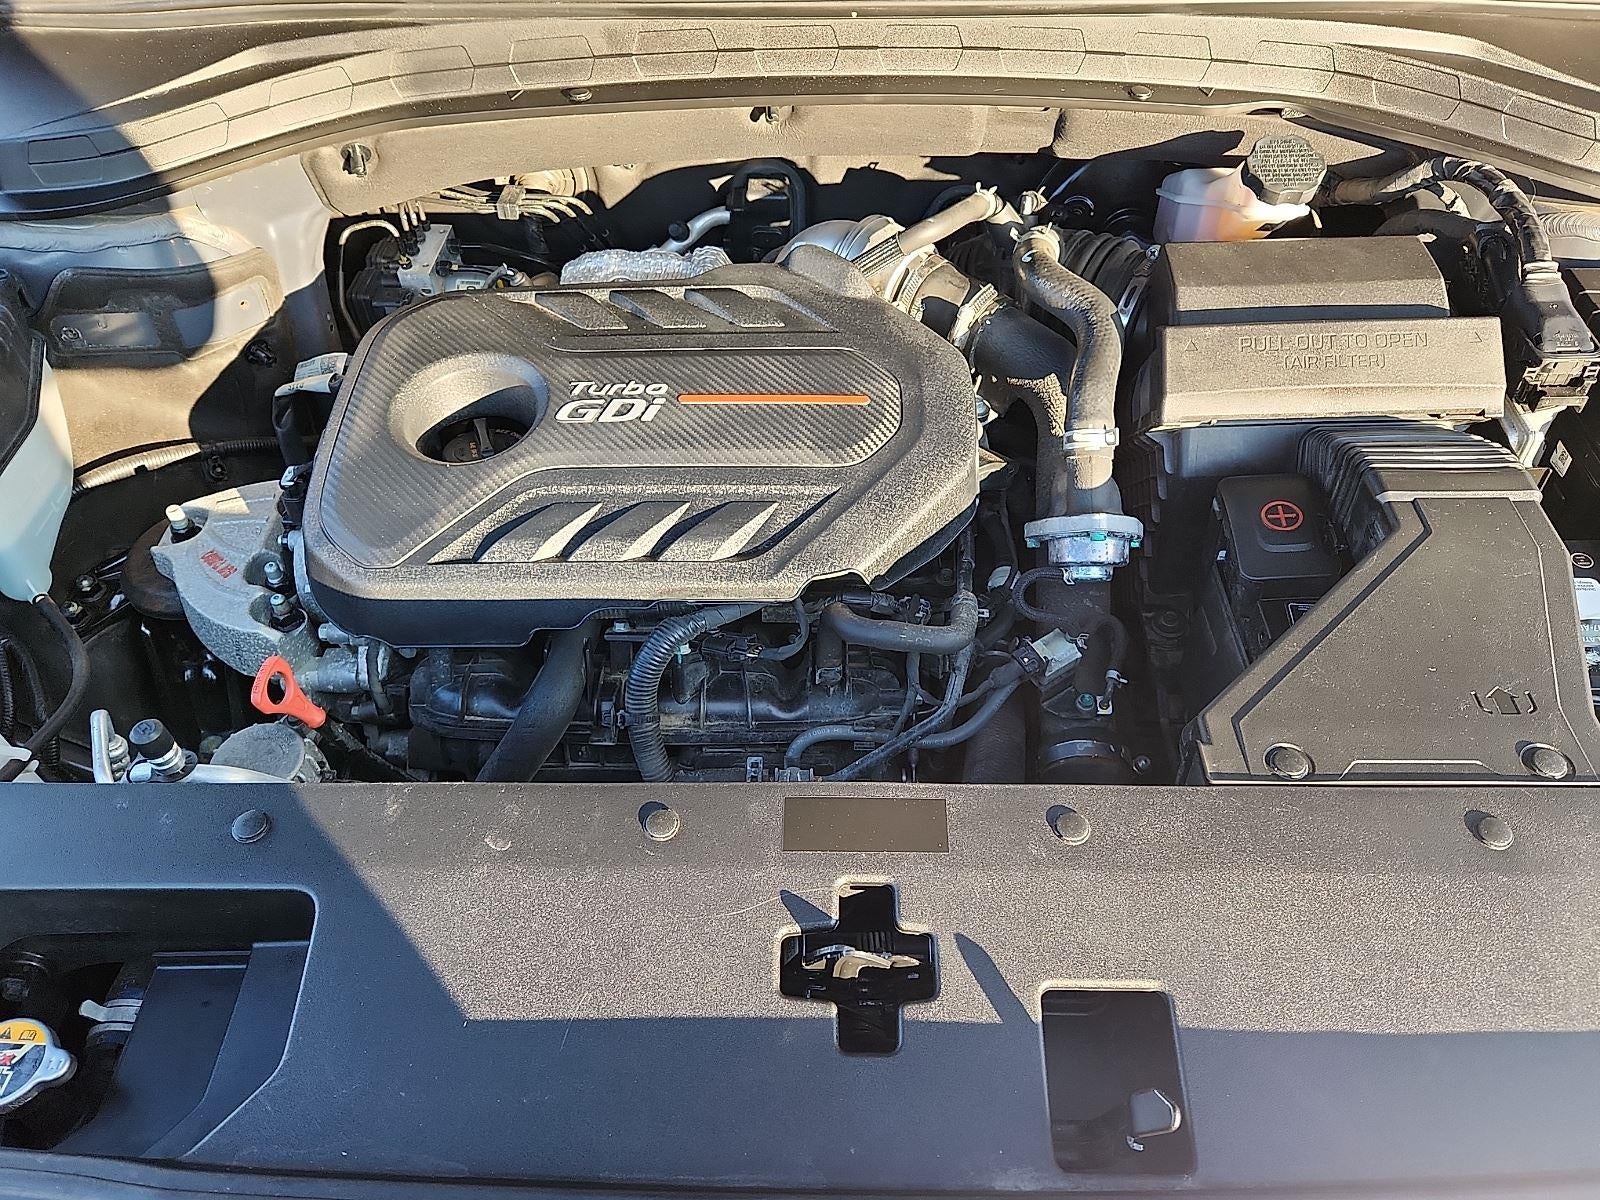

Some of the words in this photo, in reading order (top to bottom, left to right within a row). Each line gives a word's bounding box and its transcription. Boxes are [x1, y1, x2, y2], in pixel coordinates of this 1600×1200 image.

[1239, 336, 1290, 352] PULL
[1297, 334, 1337, 351] OUT
[1342, 333, 1368, 350] TO
[1375, 332, 1428, 349] OPEN
[1284, 354, 1319, 369] (AIR
[1324, 353, 1386, 369] FILTER)
[569, 380, 669, 396] Turbo
[554, 397, 667, 423] GDi
